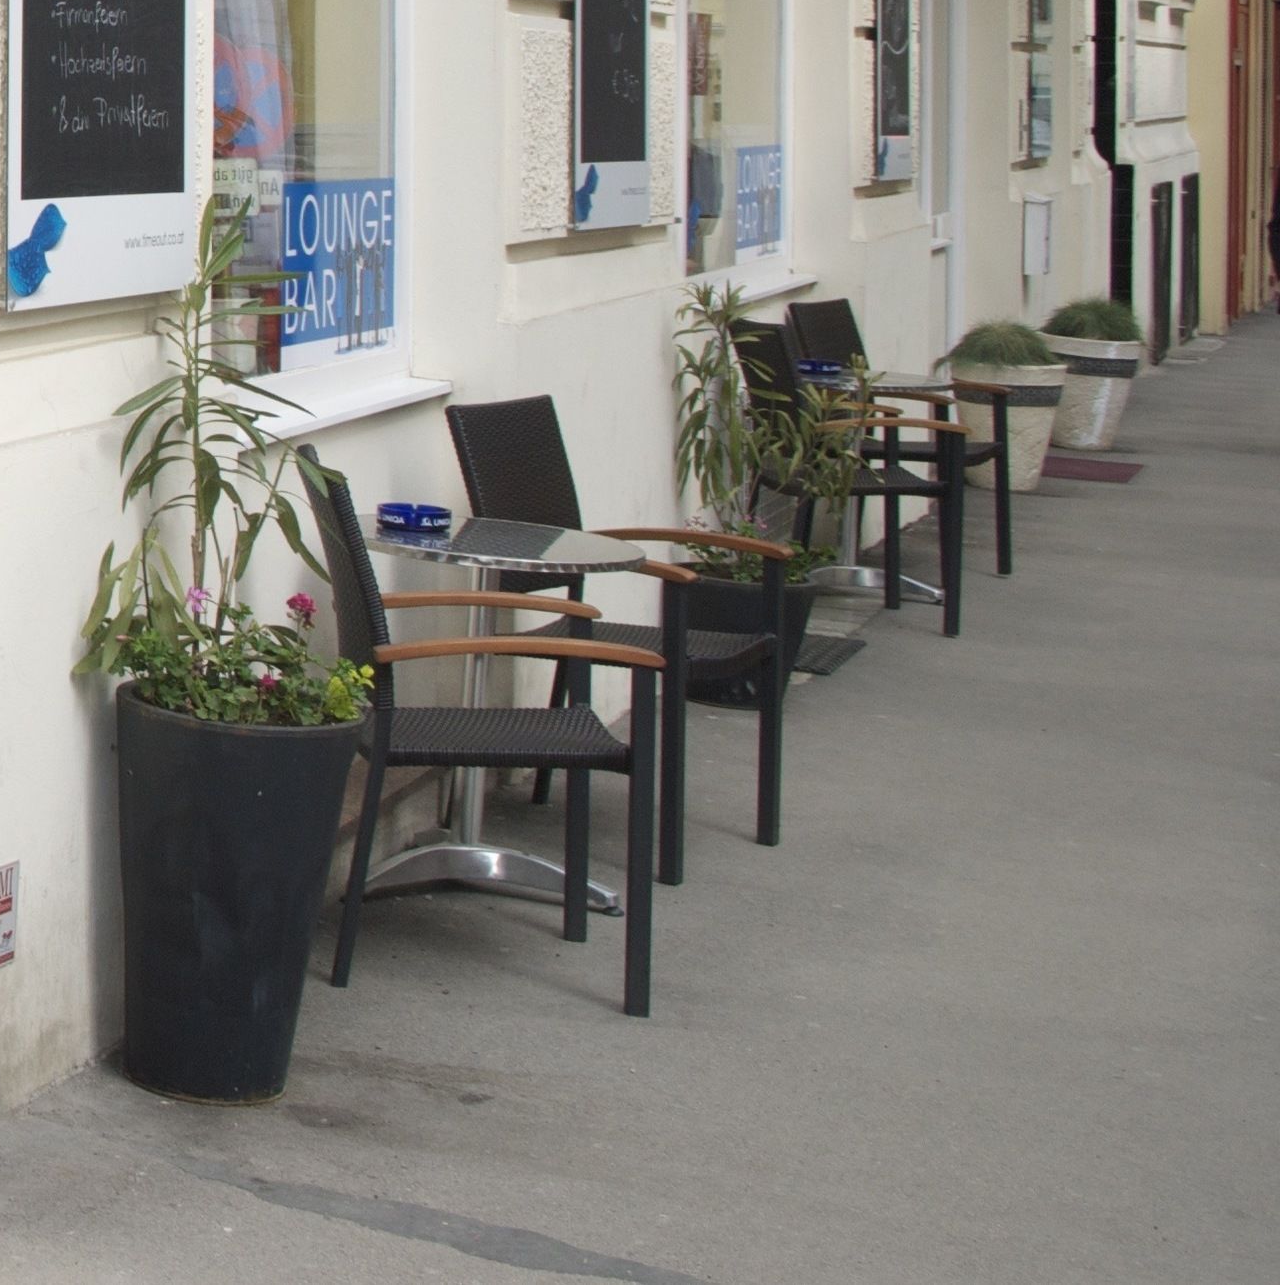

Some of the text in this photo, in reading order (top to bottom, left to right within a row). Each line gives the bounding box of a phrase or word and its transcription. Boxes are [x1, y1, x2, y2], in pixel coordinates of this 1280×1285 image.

[736, 152, 782, 195] LOUNGE
[284, 190, 393, 258] LOUNGE
[284, 268, 337, 335] BAR
